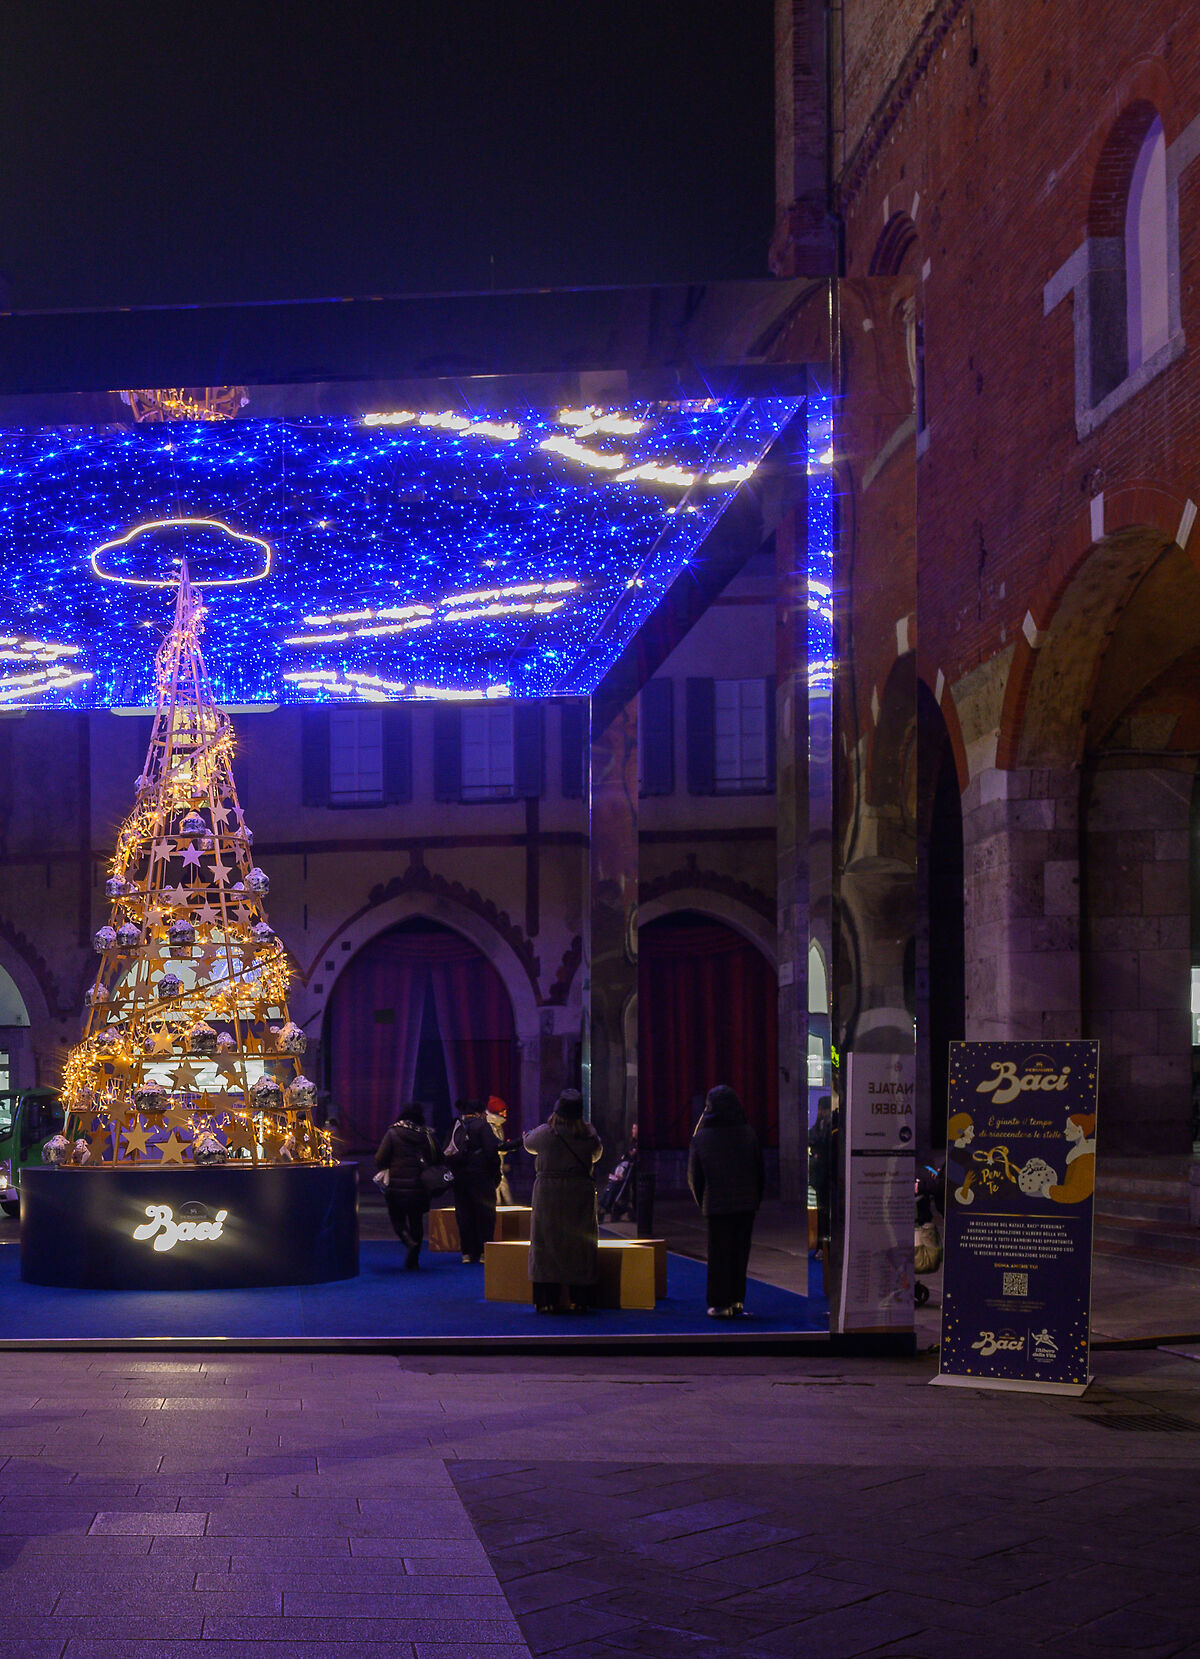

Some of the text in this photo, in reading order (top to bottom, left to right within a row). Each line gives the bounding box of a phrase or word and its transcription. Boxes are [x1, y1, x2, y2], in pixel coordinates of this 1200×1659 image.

[975, 1061, 1071, 1104] Baci
[1030, 1117, 1053, 1129] tempo
[981, 1168, 1001, 1183] Per
[133, 1204, 228, 1252] Baci
[970, 1331, 1025, 1356] Baci
